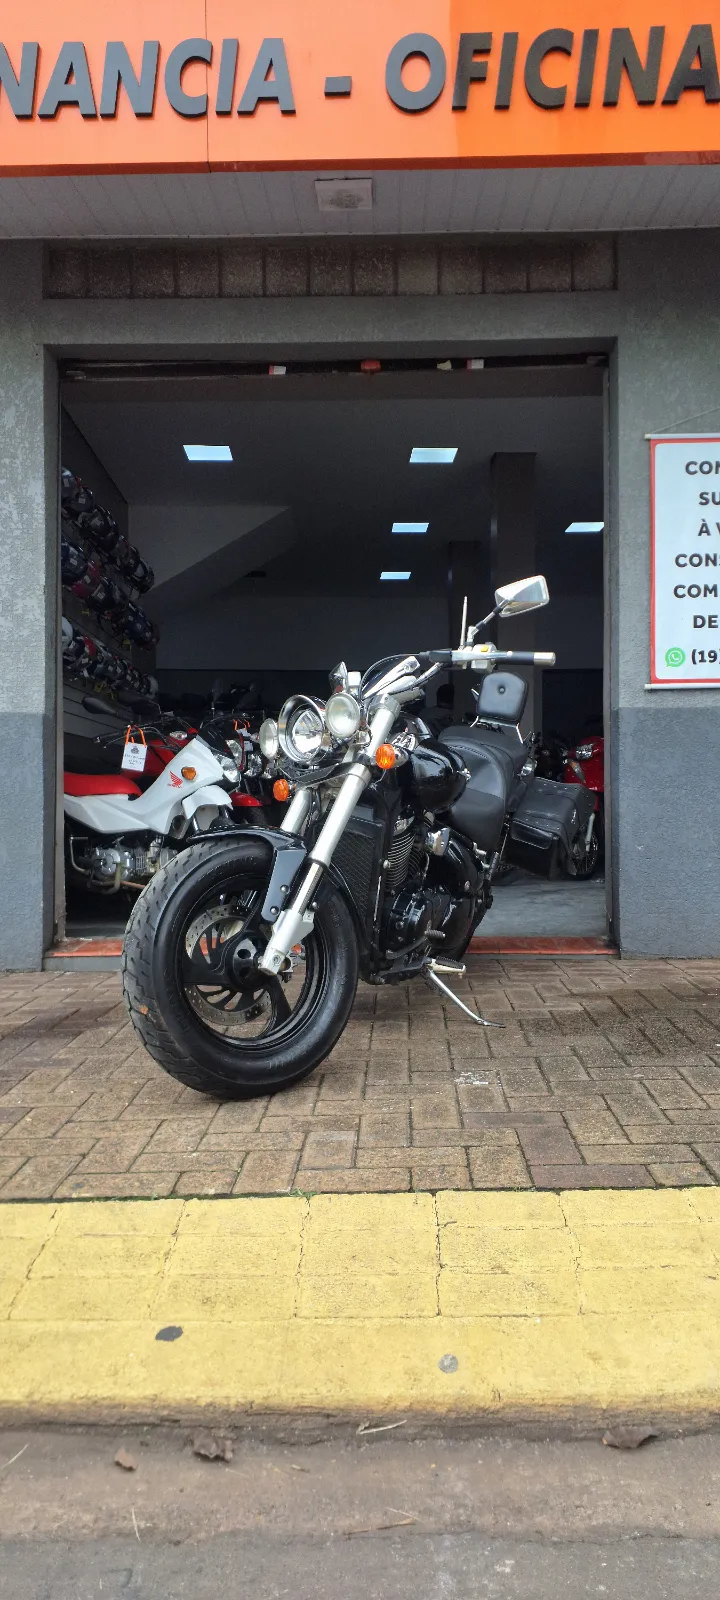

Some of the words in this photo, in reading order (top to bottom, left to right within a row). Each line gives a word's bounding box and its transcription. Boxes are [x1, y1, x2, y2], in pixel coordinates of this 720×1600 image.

[0, 38, 296, 119] NANCIA
[324, 76, 352, 96] -
[385, 24, 720, 113] OFICINA
[698, 518, 711, 536] À
[675, 553, 720, 568] CON
